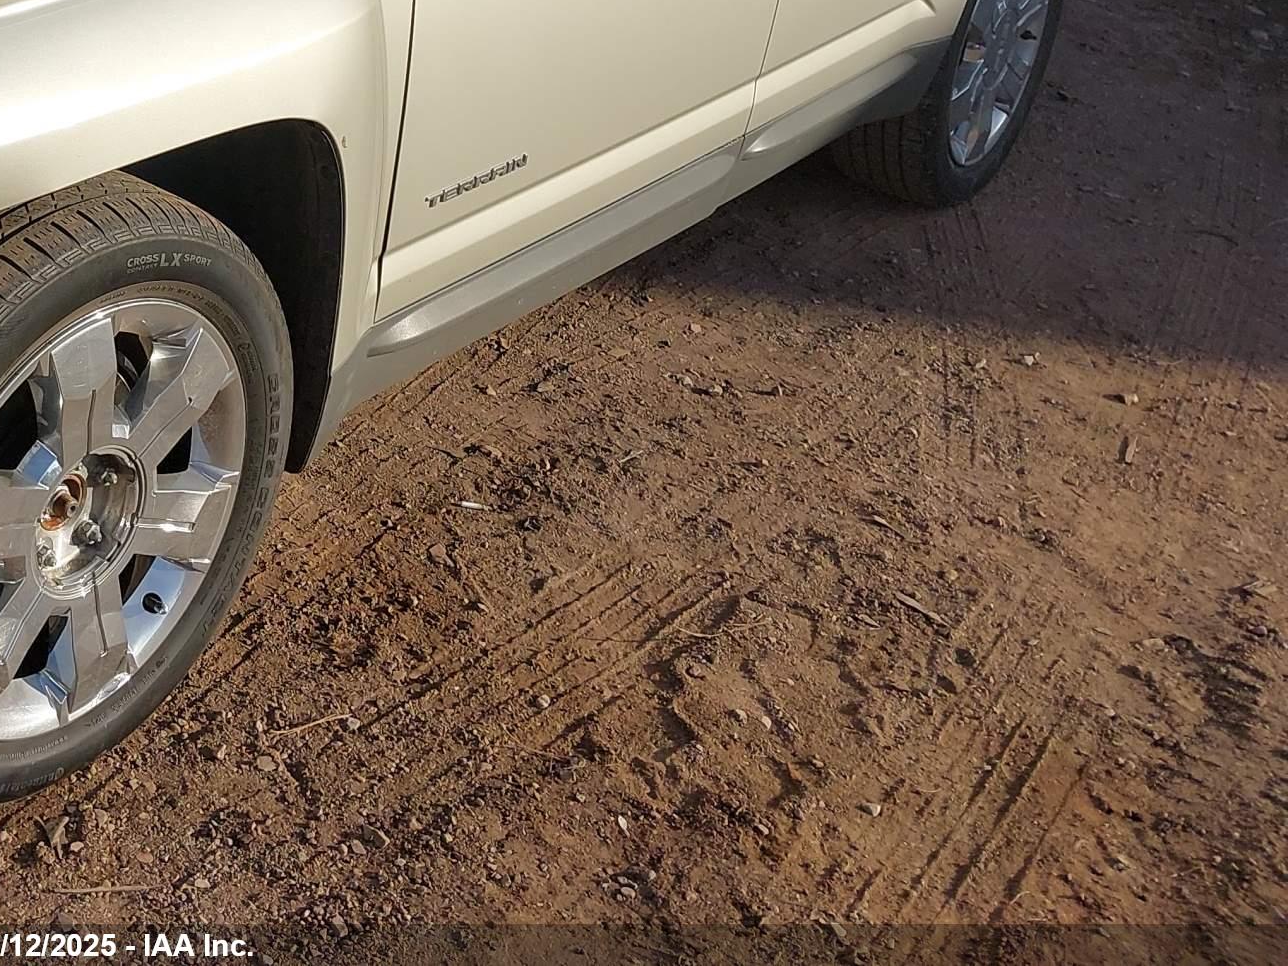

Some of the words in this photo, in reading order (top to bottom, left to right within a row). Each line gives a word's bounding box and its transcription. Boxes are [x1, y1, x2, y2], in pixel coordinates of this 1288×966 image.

[424, 152, 529, 209] TERRAIN
[126, 252, 160, 268] CROSS
[183, 253, 213, 267] SPORT
